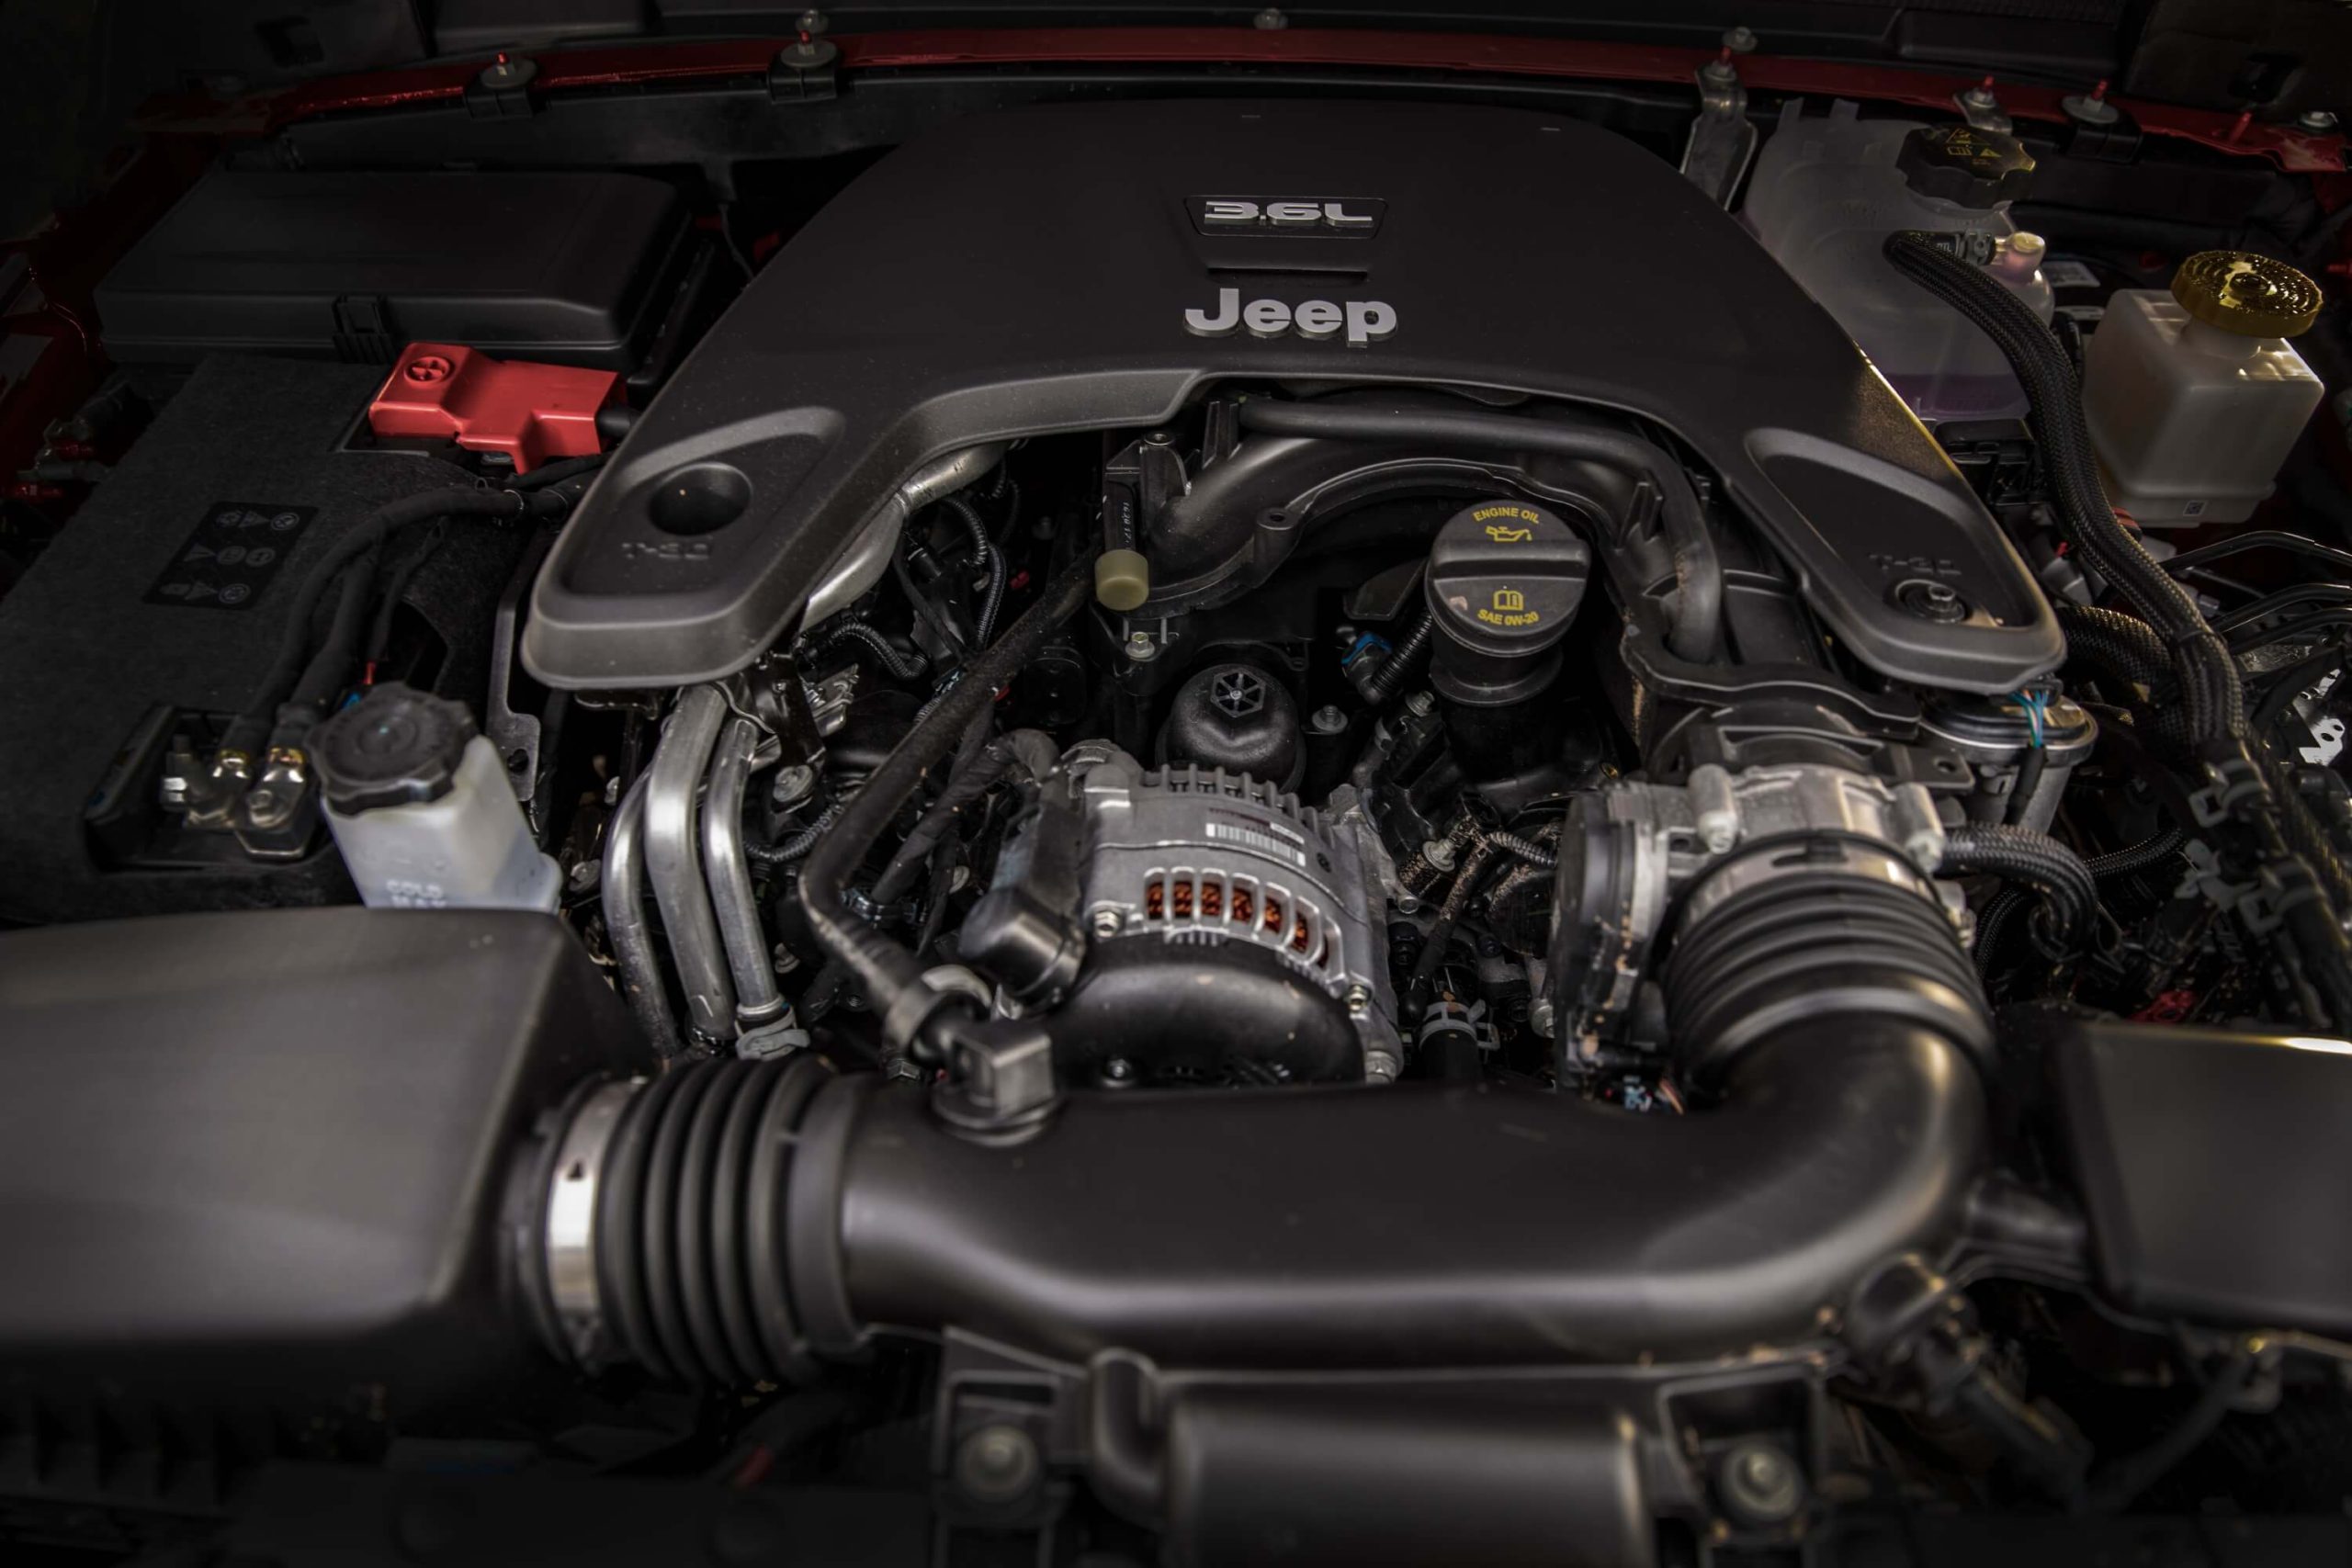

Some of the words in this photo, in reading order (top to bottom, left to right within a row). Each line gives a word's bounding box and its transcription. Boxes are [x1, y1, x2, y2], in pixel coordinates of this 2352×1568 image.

[1204, 200, 1374, 227] 3.6L
[1183, 288, 1398, 348] Jeep
[1472, 506, 1520, 523] ENGINE
[1521, 509, 1540, 525] OIL
[1476, 608, 1503, 626] SAE
[1503, 611, 1540, 626] 0W-20
